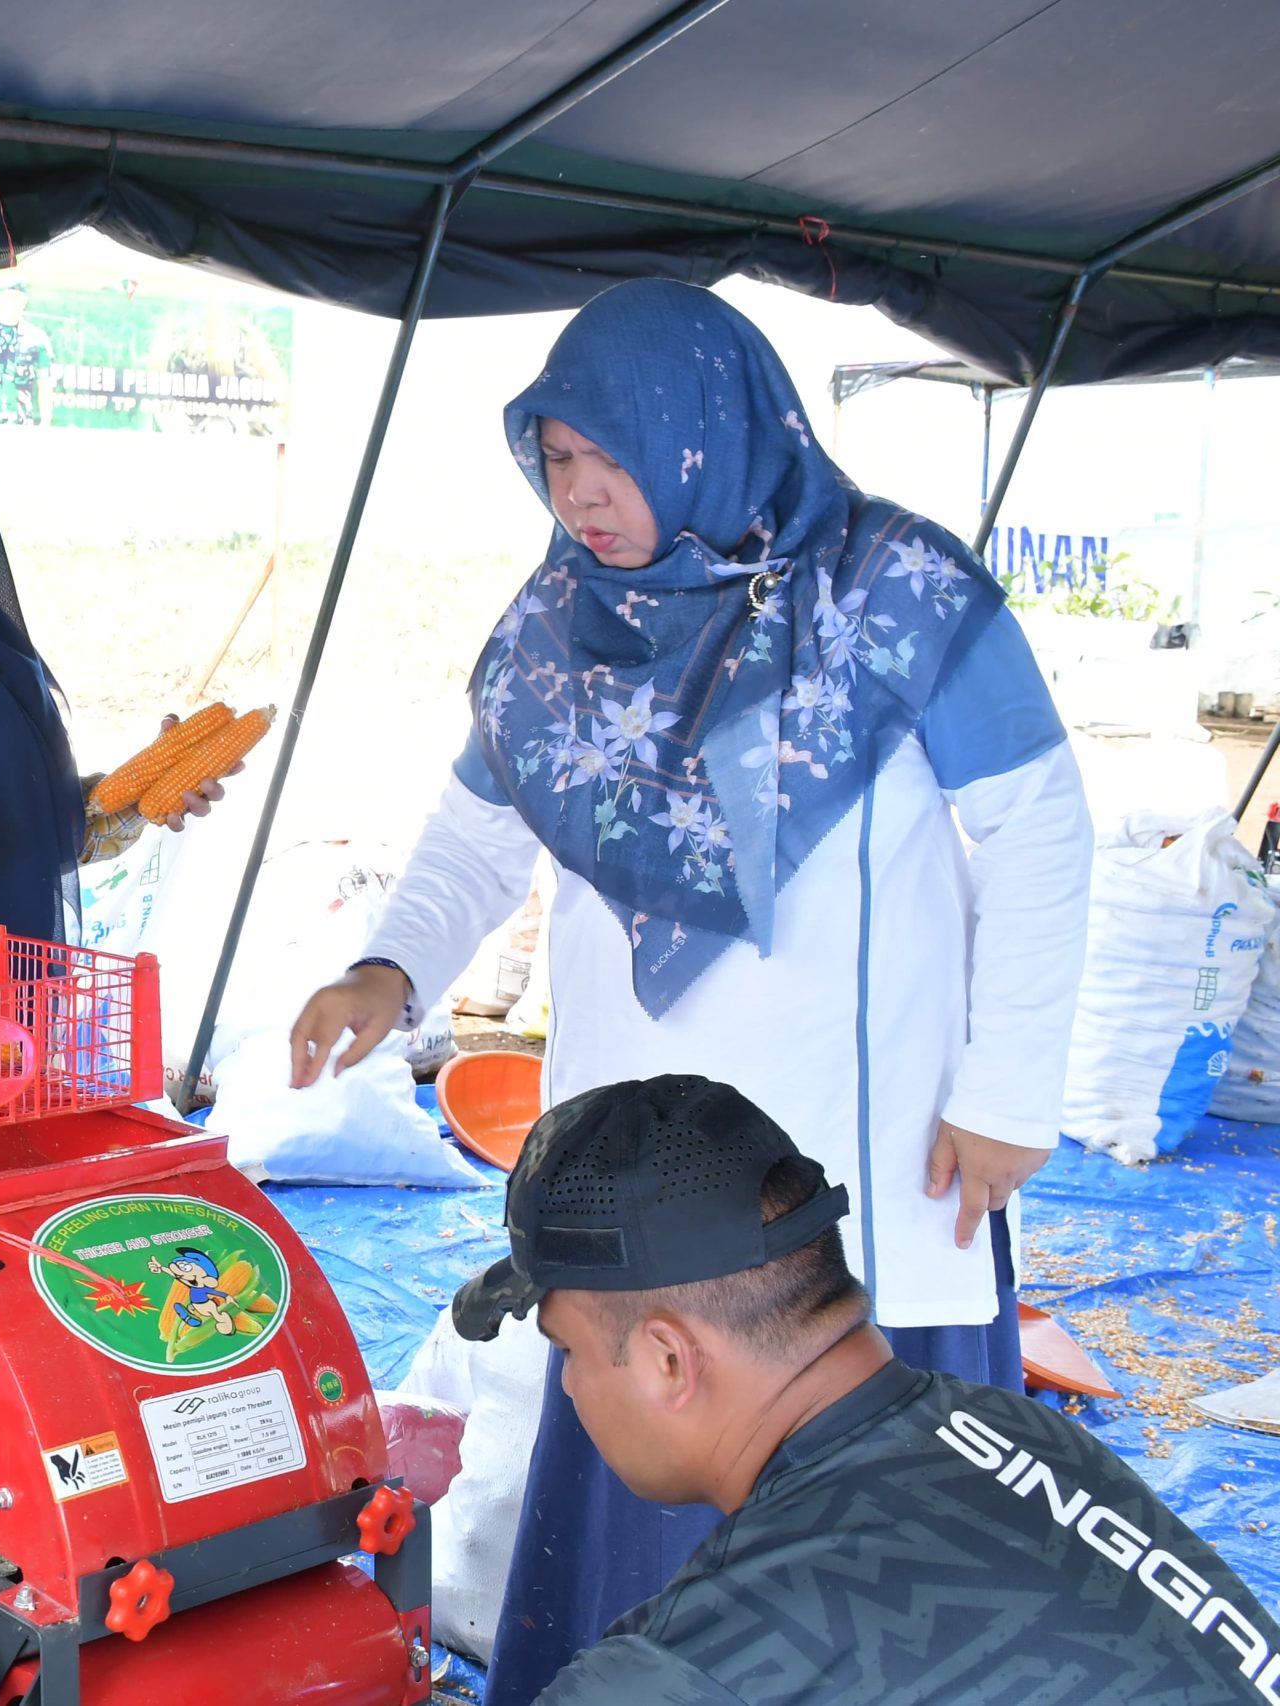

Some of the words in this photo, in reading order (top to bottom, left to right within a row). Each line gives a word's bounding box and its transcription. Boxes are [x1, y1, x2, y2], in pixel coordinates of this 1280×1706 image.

[59, 1209, 110, 1239] PEELING
[108, 1202, 151, 1216] CORN
[151, 1202, 239, 1232] THRESHER
[72, 1241, 126, 1260] THICKER
[125, 1236, 150, 1251] AND
[150, 1224, 213, 1245] STRONGER
[231, 1406, 246, 1414] Corn
